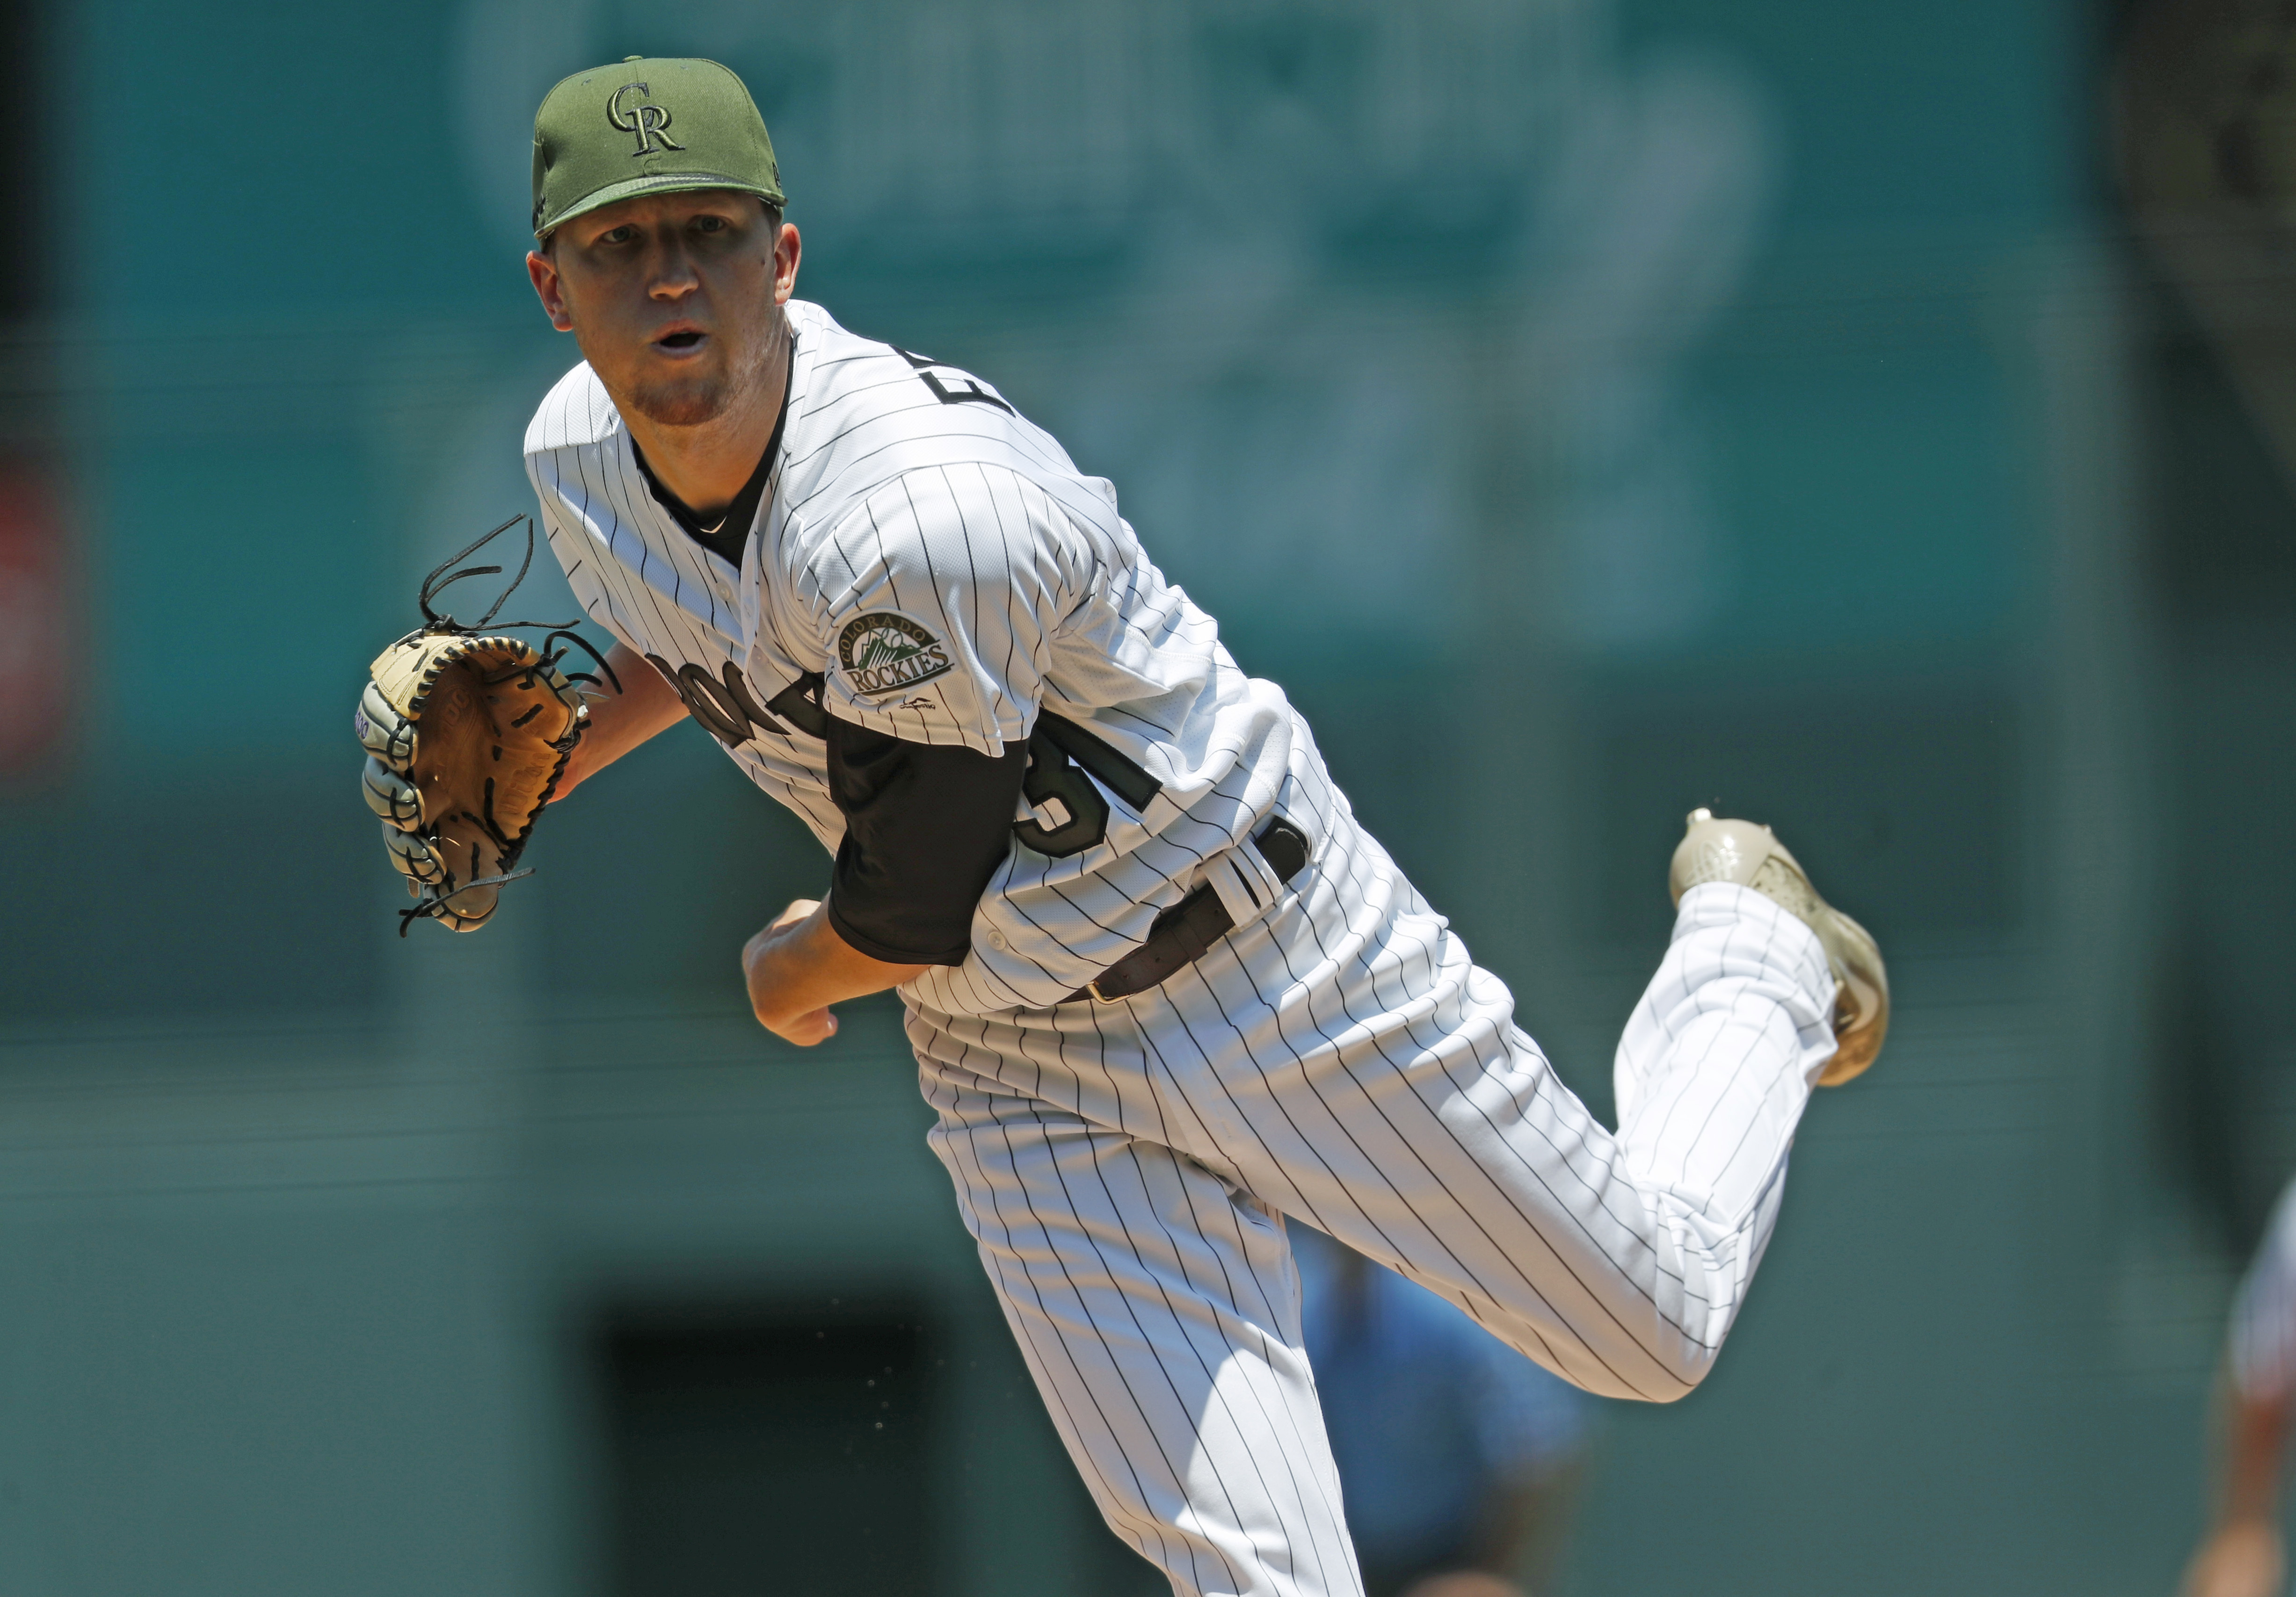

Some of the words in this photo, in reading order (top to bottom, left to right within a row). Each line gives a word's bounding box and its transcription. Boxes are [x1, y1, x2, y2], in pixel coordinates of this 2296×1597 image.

[607, 82, 685, 157] CR
[840, 615, 926, 662] COLORADO
[846, 644, 949, 692] ROCKIES
[1012, 706, 1163, 859] 31
